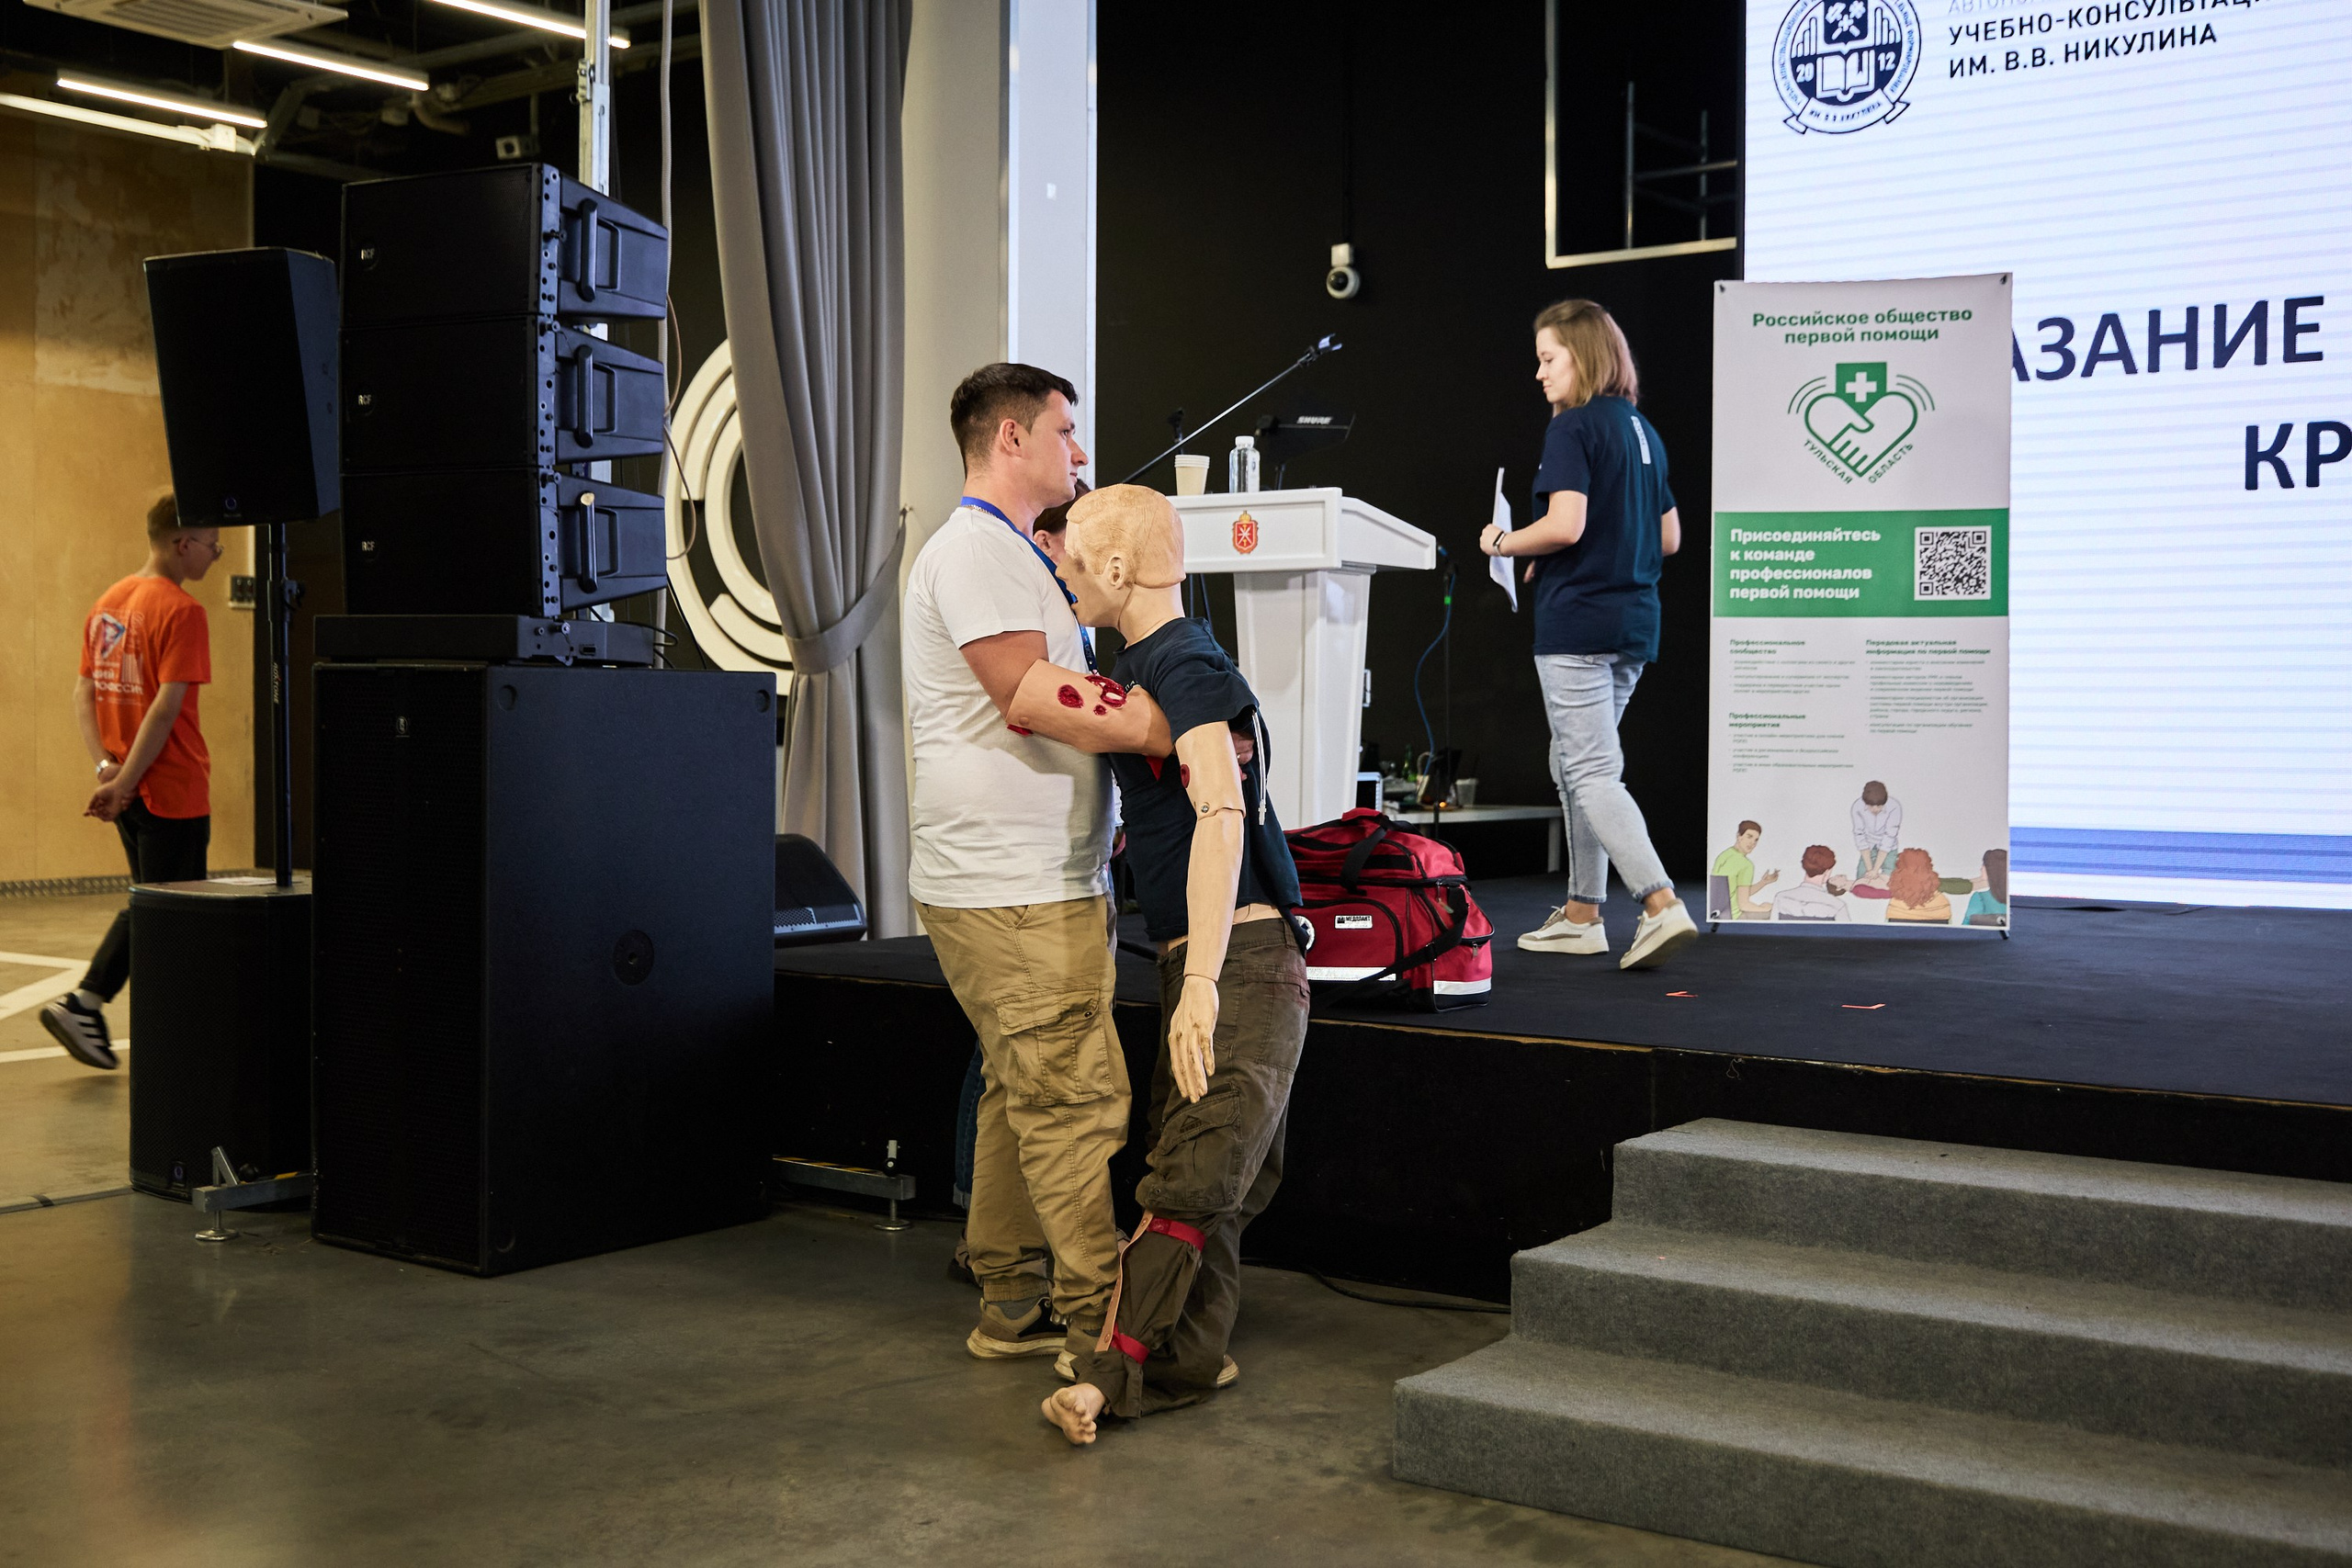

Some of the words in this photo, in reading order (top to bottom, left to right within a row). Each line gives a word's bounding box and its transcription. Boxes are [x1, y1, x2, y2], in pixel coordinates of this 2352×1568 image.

[1950, 56, 1996, 79] ИМ.
[2005, 47, 2054, 71] В.В.
[2064, 23, 2218, 63] НИКУЛИНА
[1795, 62, 1815, 84] 20
[1877, 51, 1896, 73] 12
[1753, 310, 1870, 328] Российское
[1874, 308, 1973, 325] общество
[1784, 327, 1855, 347] первой
[1860, 328, 1939, 343] помощи
[358, 394, 371, 405] RCF
[1296, 415, 1333, 424] SHURE
[1804, 439, 1853, 484] ТУЛЬСКАЯ
[1868, 442, 1914, 484] ОБЛАСТЬ
[1730, 527, 1882, 545] Присоединяйтесь
[362, 541, 375, 551] RCF
[1730, 550, 1740, 561] к
[1744, 549, 1815, 563] команде
[1730, 565, 1872, 583] профессионалов
[1730, 584, 1791, 602] первой
[1793, 587, 1860, 602] помощи
